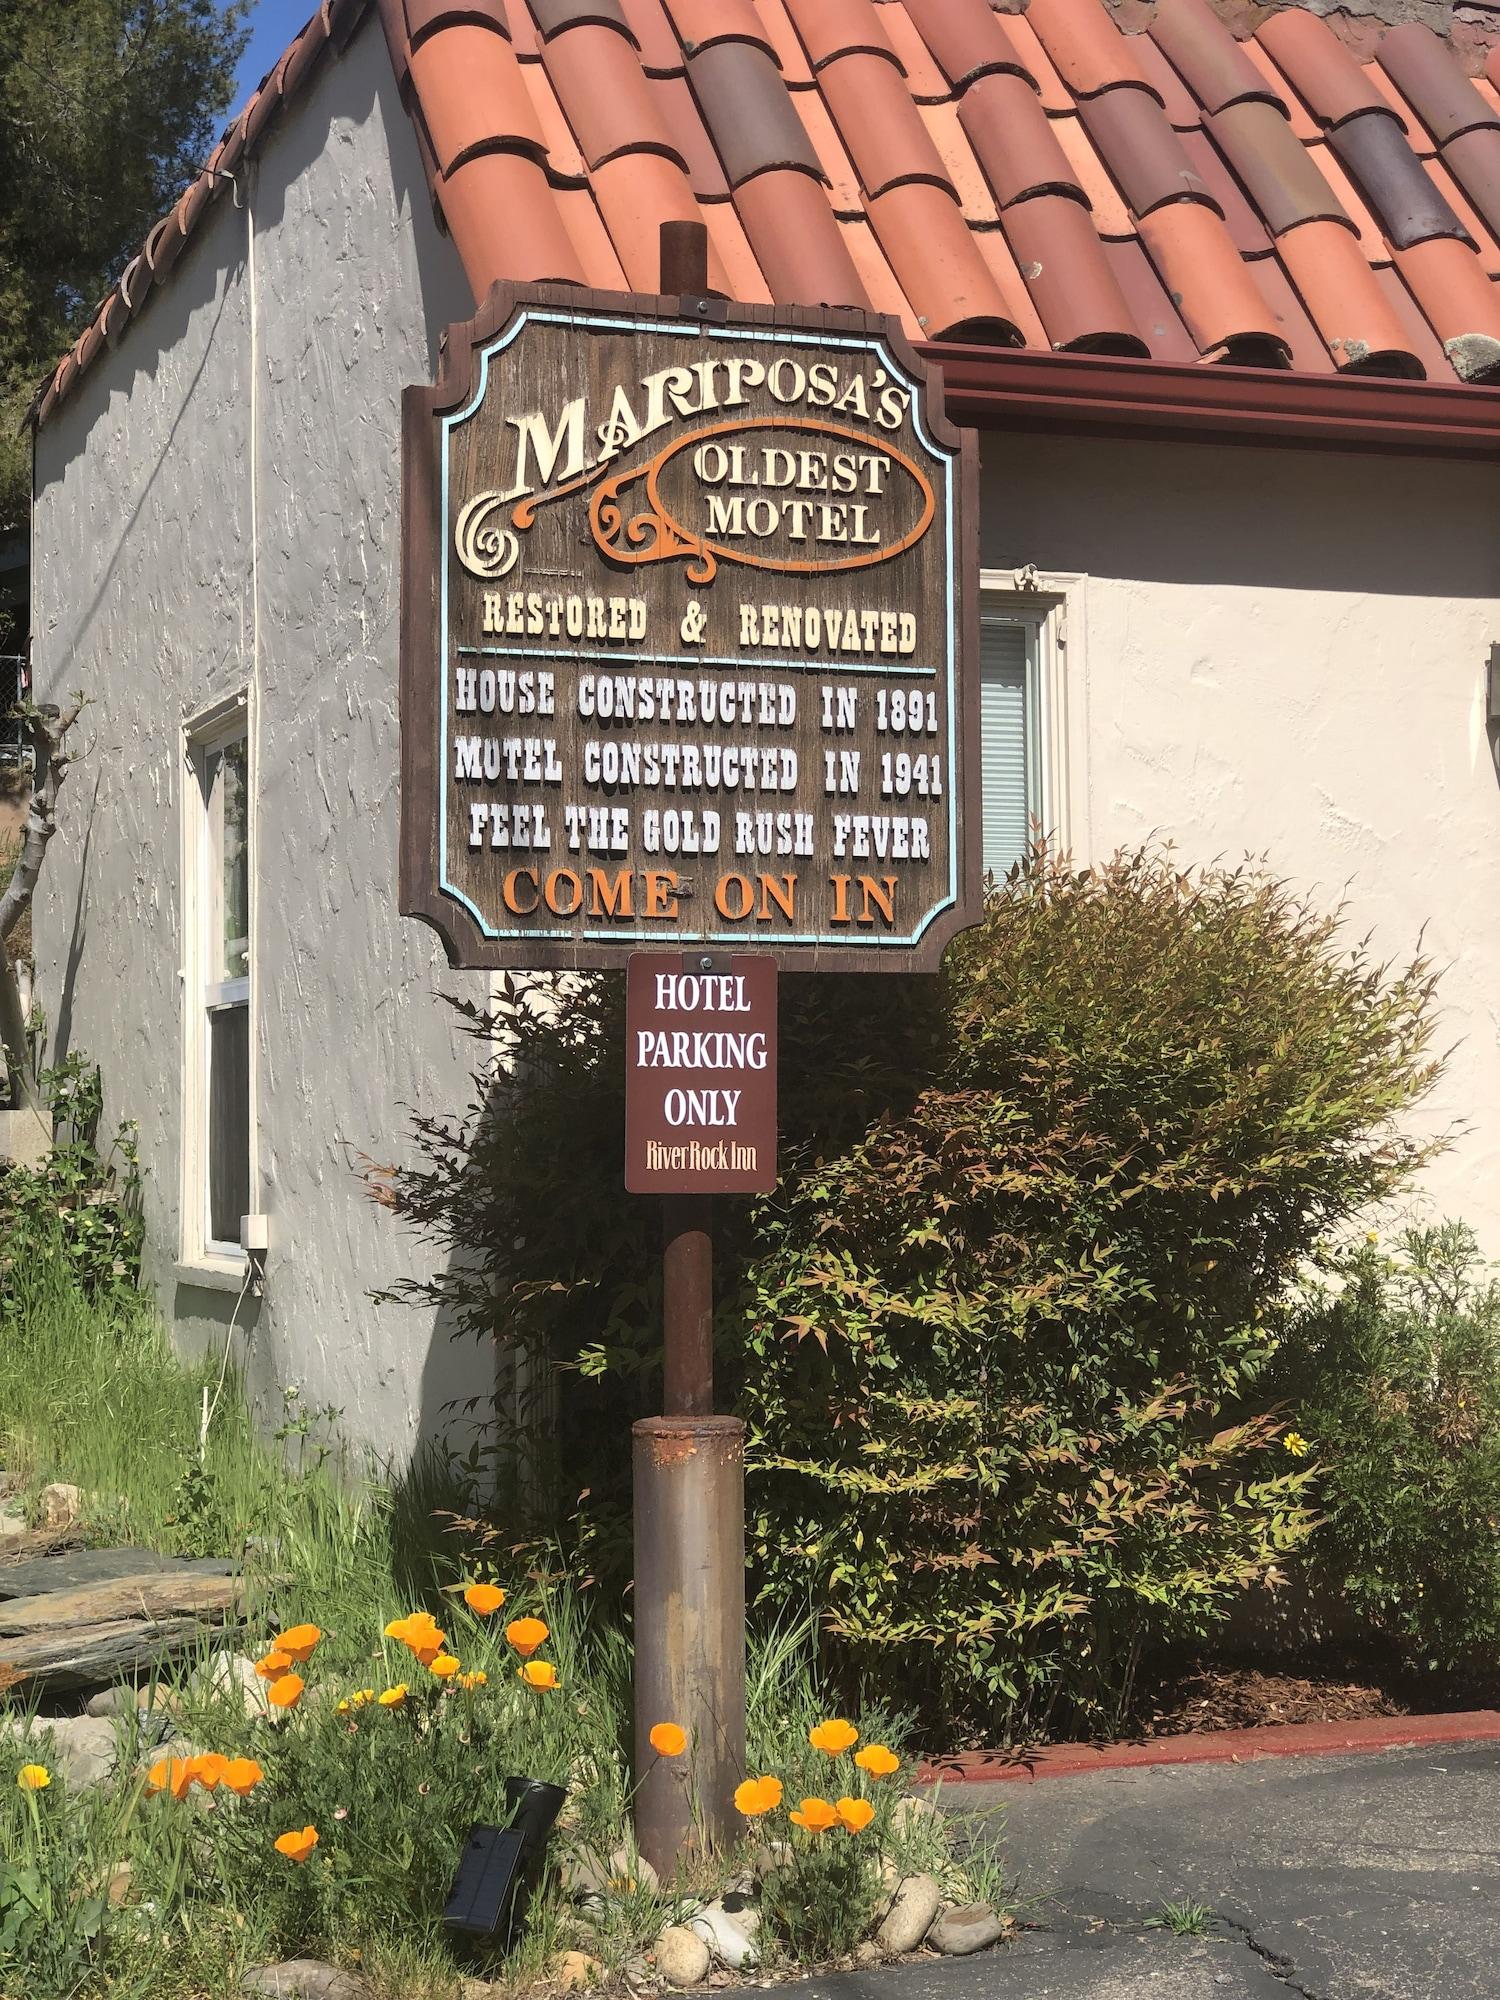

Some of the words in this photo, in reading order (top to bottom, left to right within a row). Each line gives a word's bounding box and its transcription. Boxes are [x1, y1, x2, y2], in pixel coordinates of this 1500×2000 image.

[507, 358, 911, 492] MARIPOSA'S
[694, 444, 890, 494] OLDEST
[705, 495, 881, 544] MOTEL
[483, 591, 647, 641] RESTORED
[680, 600, 707, 643] &
[739, 604, 917, 655] RENOVATED
[455, 668, 555, 714] HOUSE
[578, 674, 797, 726] CONSTRUCTED
[821, 686, 857, 729] IN
[876, 689, 938, 732] 1891
[584, 740, 799, 792] CONSTRUCTED
[824, 751, 861, 793] IN
[881, 752, 943, 796] 1941
[469, 803, 551, 848] FEEL
[565, 806, 629, 851] THE
[643, 809, 721, 854] GOLD
[735, 812, 814, 857] RUSH
[833, 815, 931, 860] FEVER
[502, 867, 679, 919] COME
[714, 872, 799, 923] ON
[830, 875, 899, 923] IN
[654, 973, 751, 1012] HOTEL
[636, 1030, 768, 1070] PARKING
[664, 1088, 742, 1127] ONLY
[730, 1140, 758, 1172] Inn
